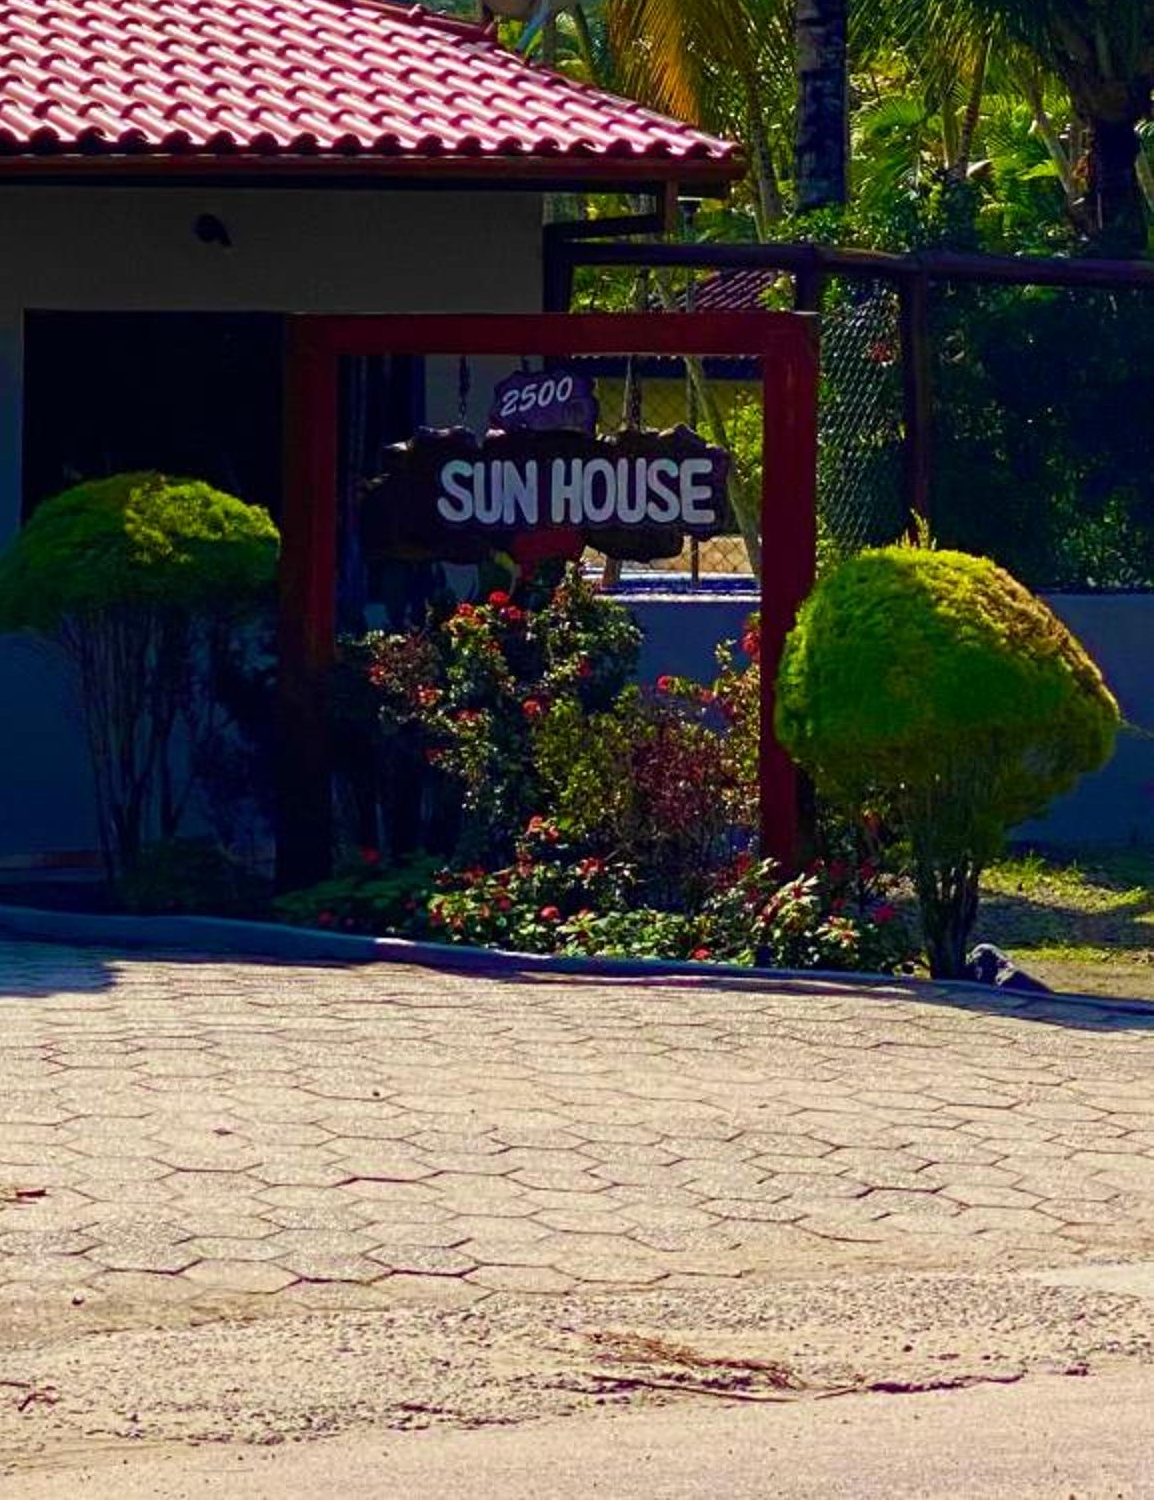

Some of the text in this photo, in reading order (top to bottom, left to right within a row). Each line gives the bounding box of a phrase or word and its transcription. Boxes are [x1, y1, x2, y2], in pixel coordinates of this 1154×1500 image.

[499, 375, 573, 417] 2500
[437, 457, 715, 525] SUN HOUSE
